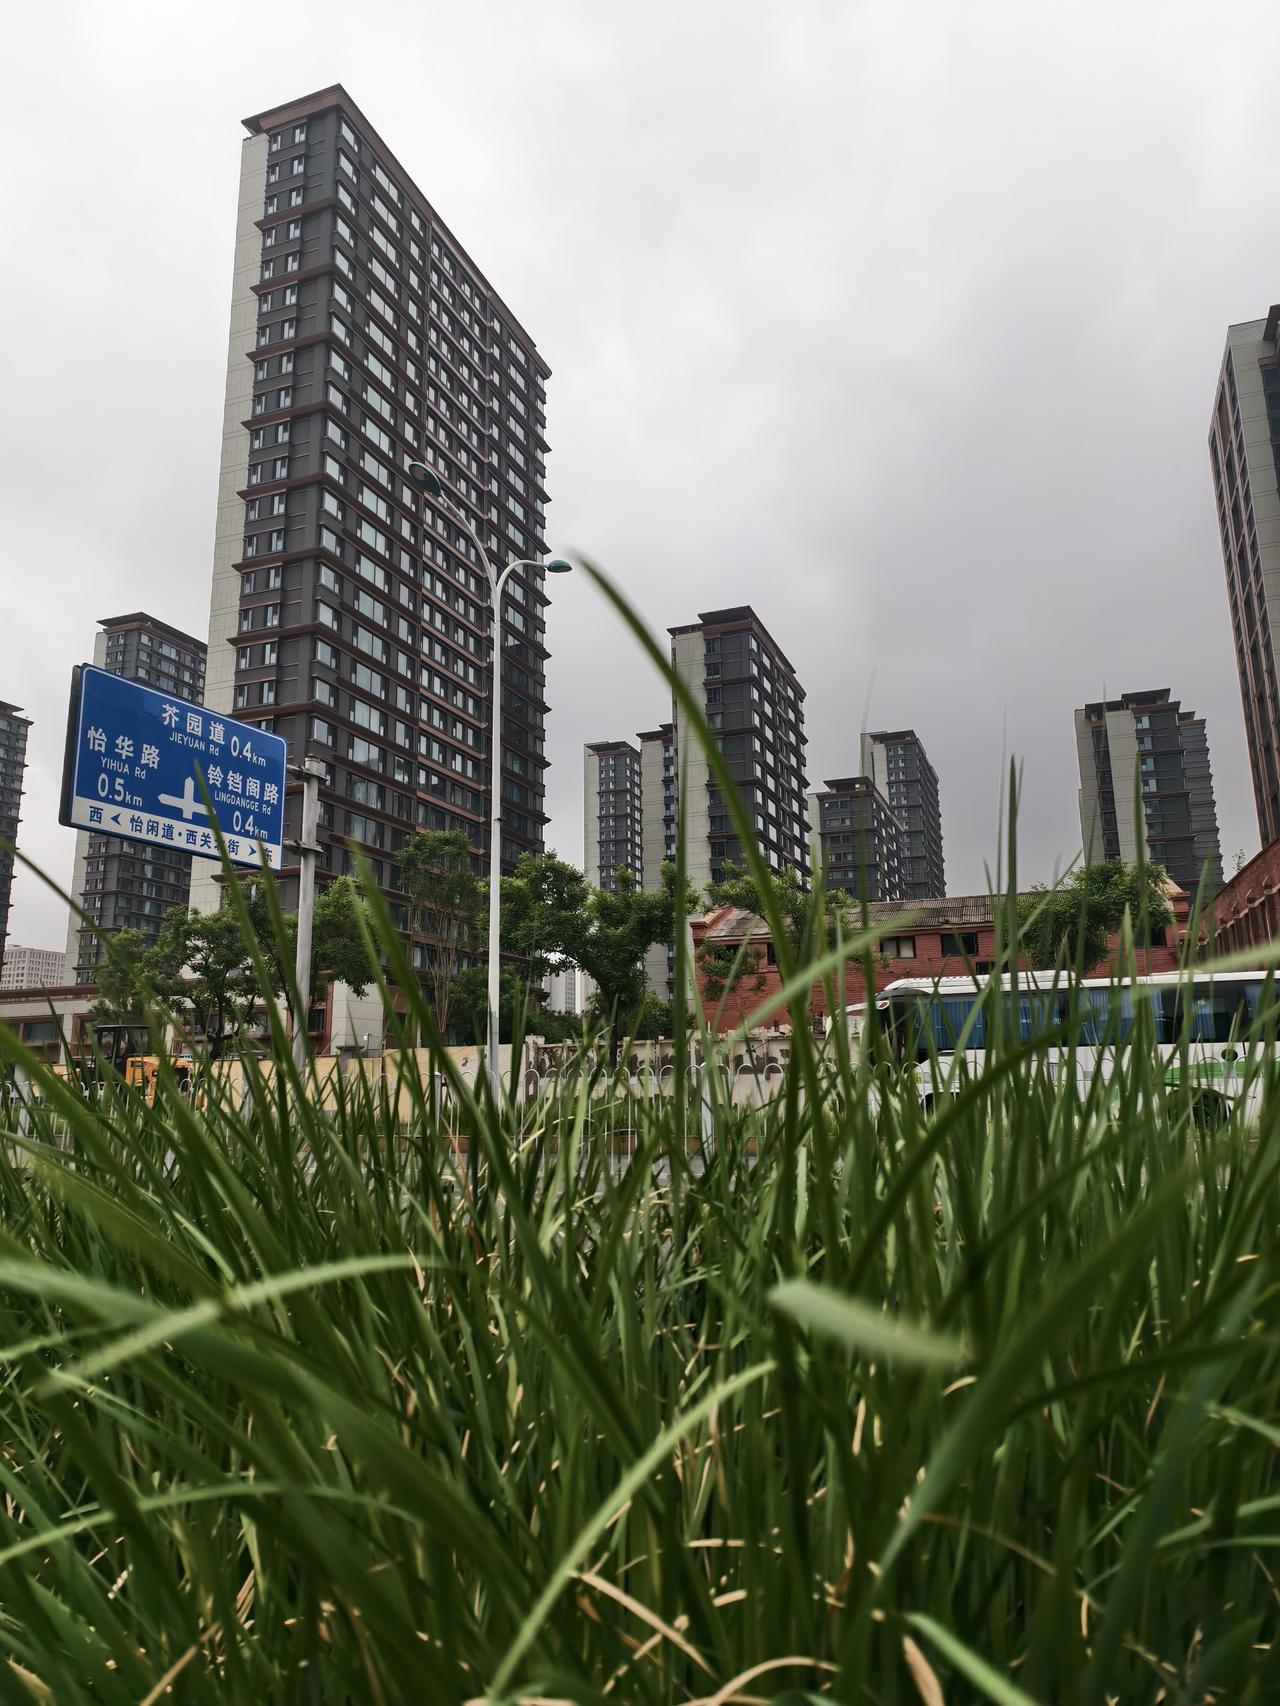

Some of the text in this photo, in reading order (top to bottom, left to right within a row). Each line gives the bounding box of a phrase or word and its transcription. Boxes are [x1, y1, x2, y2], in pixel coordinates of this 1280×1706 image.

[87, 726, 160, 769] 怡华路
[161, 703, 266, 767] 芥园道 0.4km
[169, 731, 219, 756] JIEYUAN Rd
[100, 756, 146, 779] YIHUA Rd
[207, 763, 279, 804] 铃铛阁路
[97, 772, 143, 807] 0.5km
[214, 790, 272, 815] LINGDANGGE Rd
[89, 805, 104, 824] 西
[130, 814, 239, 855] 怡闲道·西关街
[233, 810, 268, 839] 0.4km
